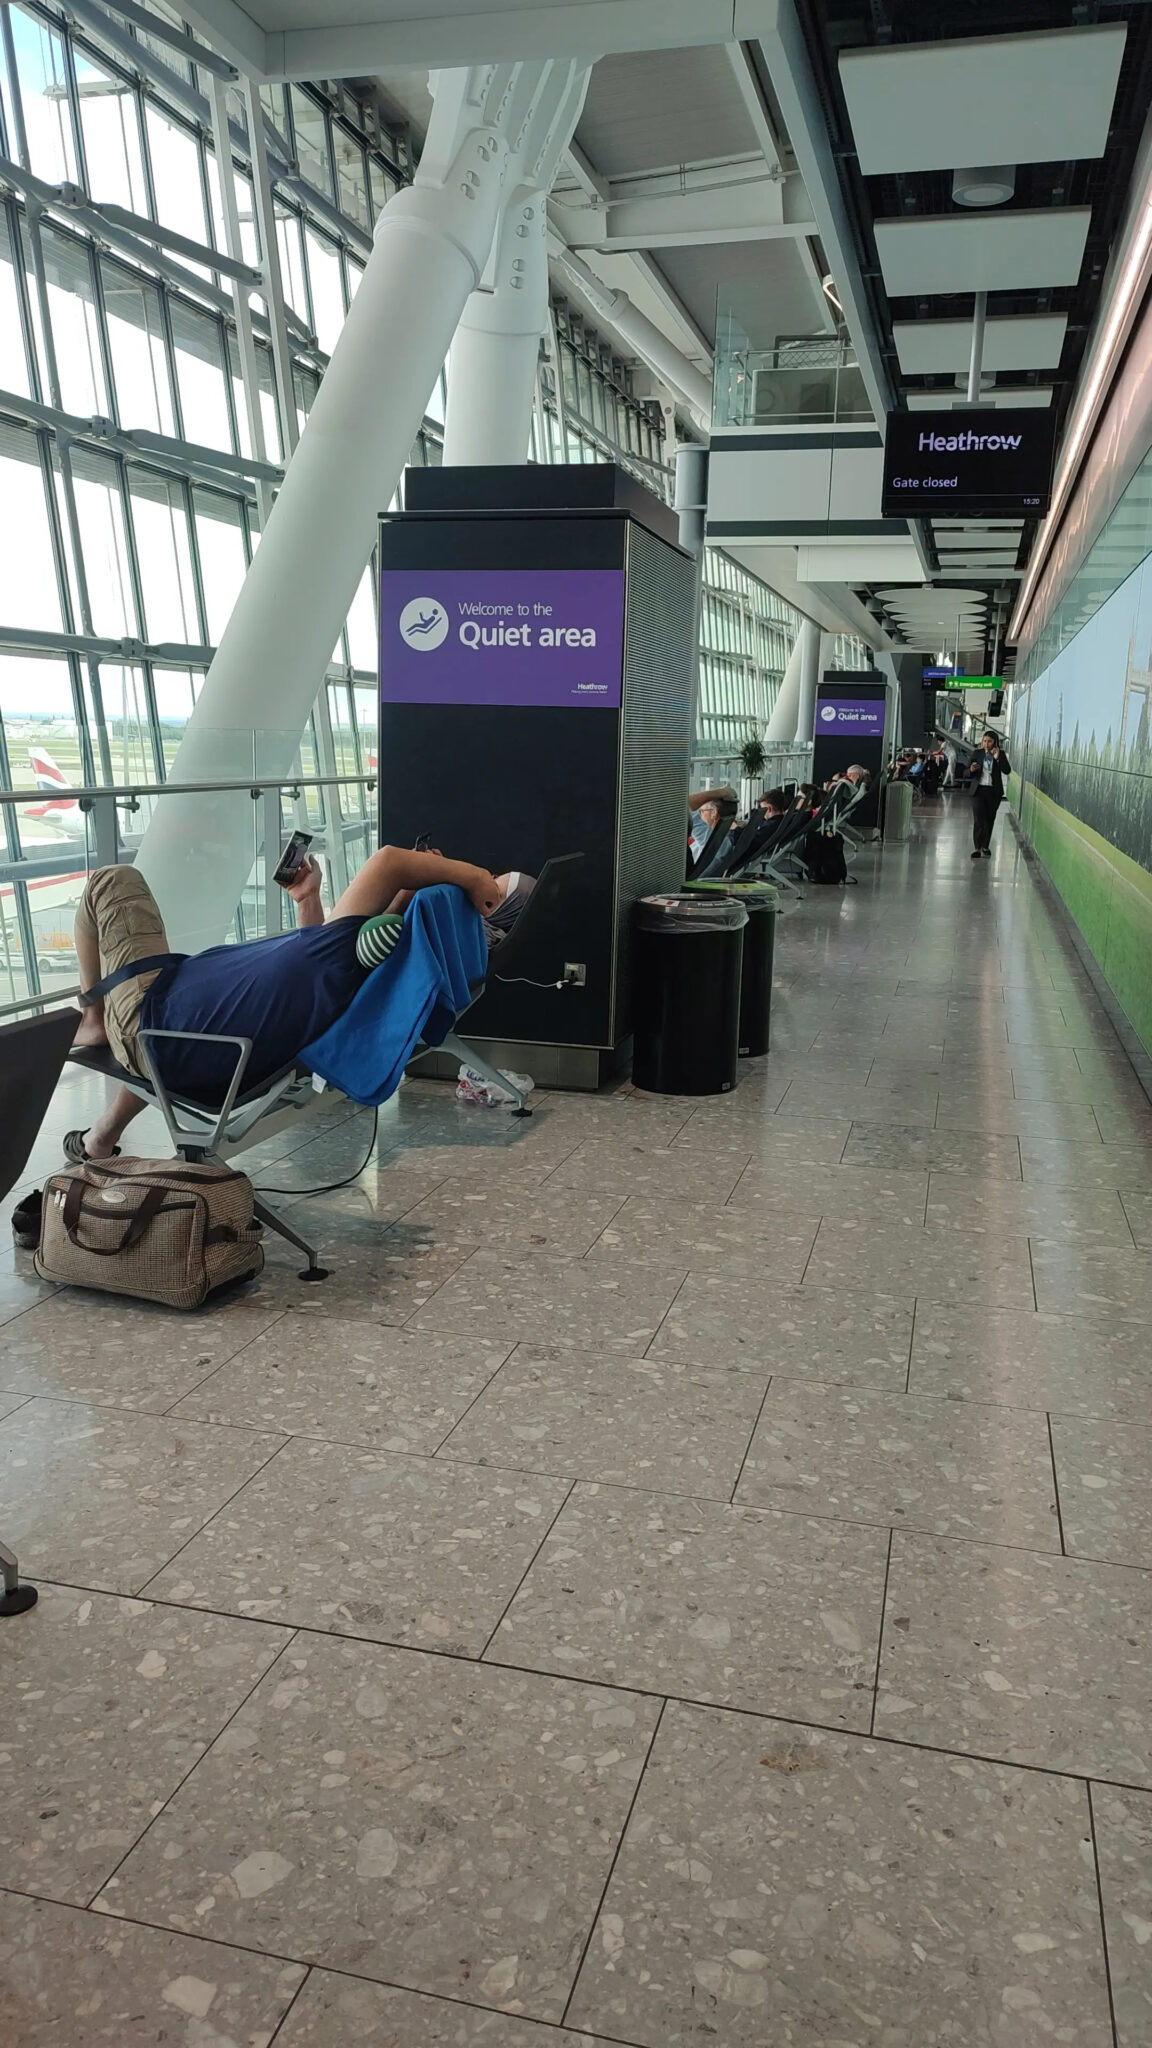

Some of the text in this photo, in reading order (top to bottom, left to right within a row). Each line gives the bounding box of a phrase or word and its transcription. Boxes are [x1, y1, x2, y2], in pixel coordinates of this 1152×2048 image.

[919, 430, 1022, 451] Heathrow
[893, 476, 958, 488] Gate closed
[458, 602, 553, 616] Welcome to the
[459, 620, 597, 650] Quiet area
[838, 712, 860, 722] Quiet
